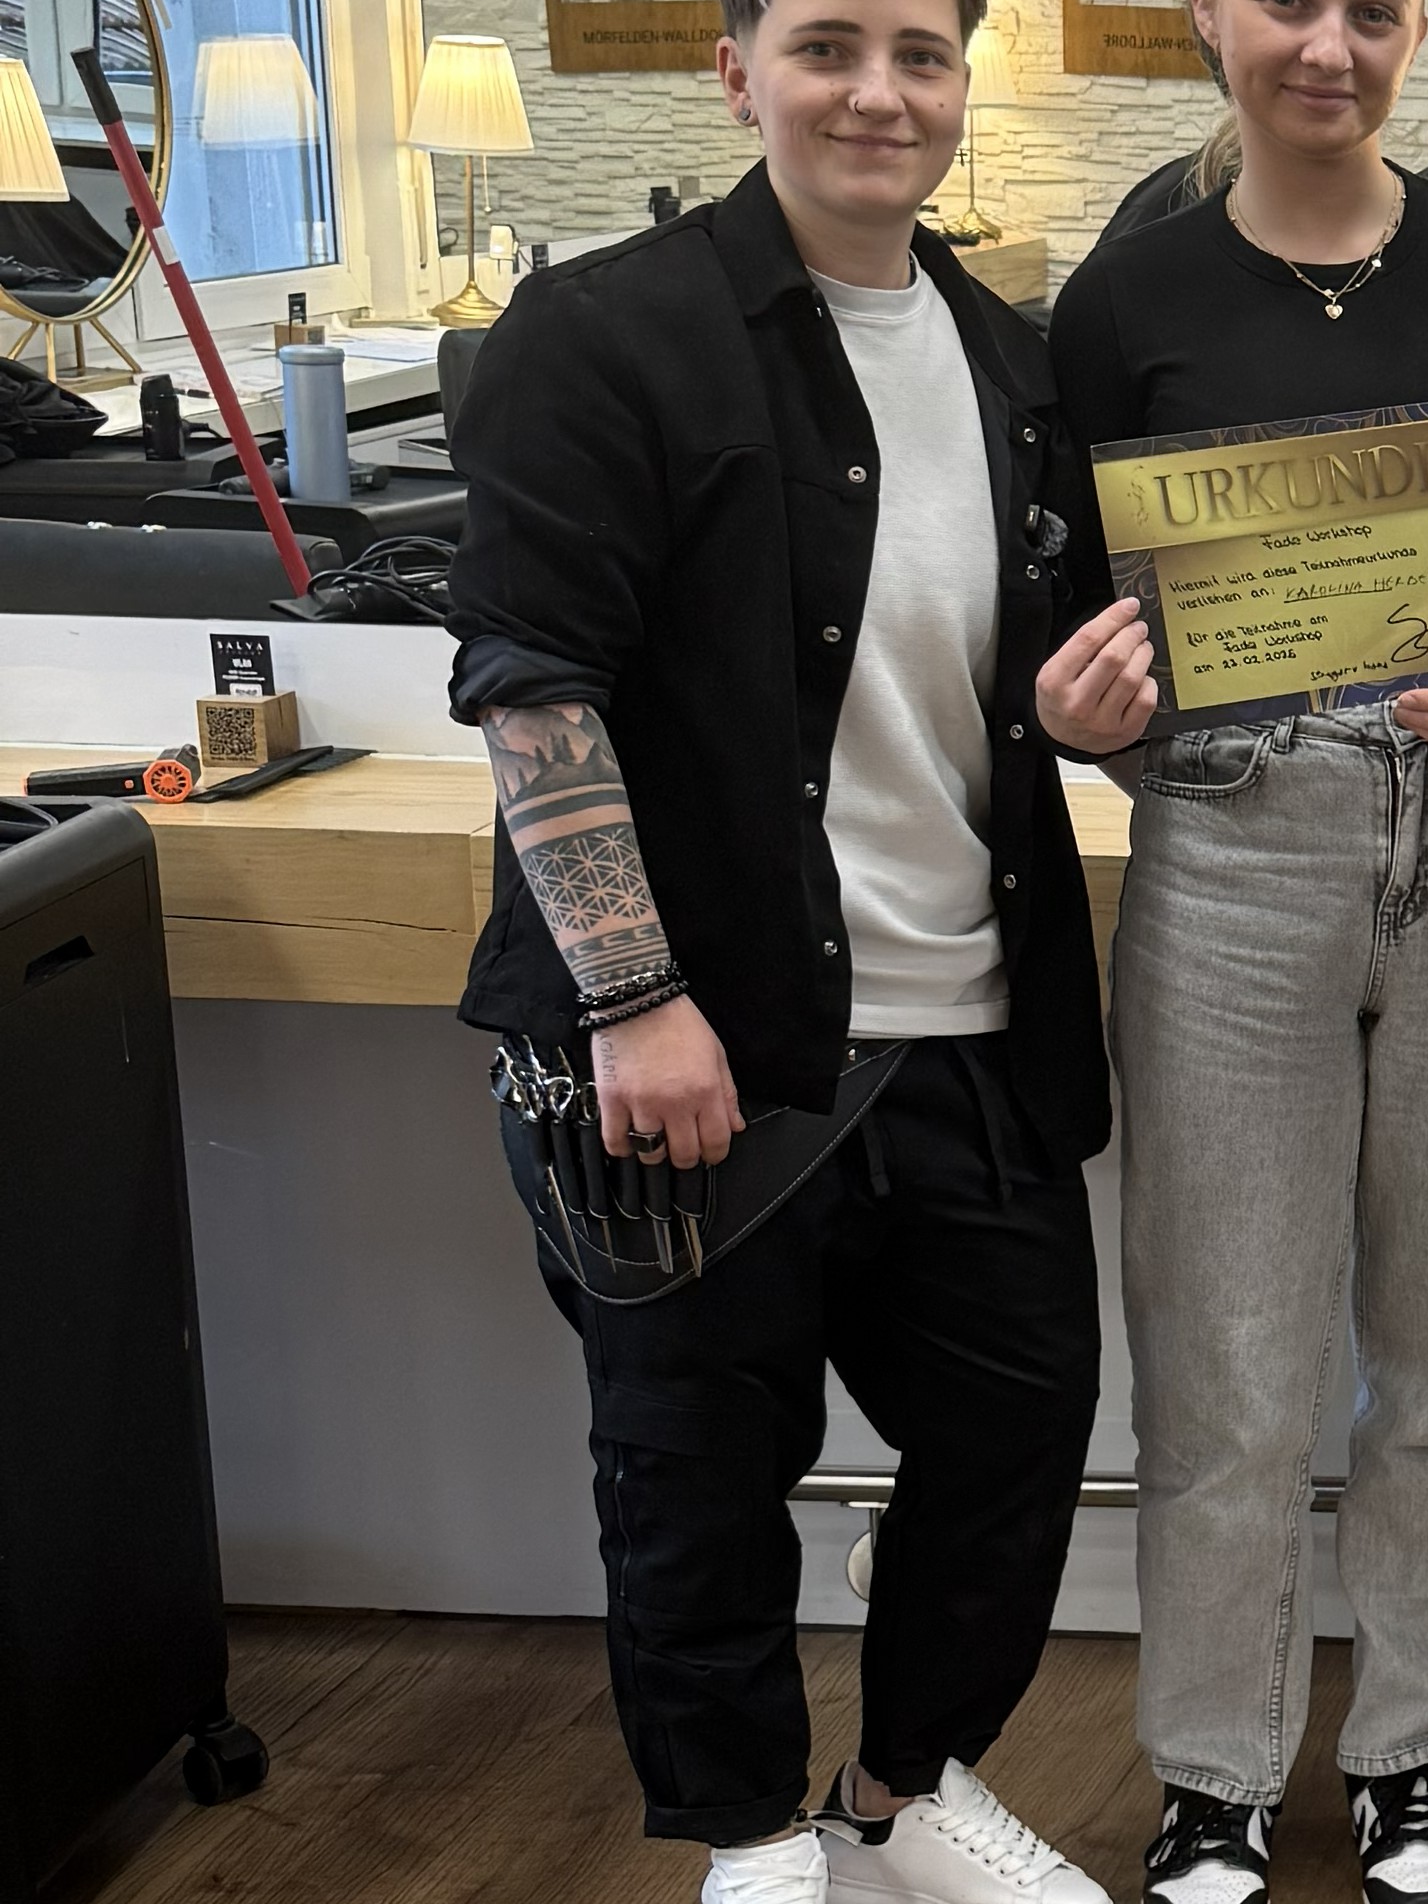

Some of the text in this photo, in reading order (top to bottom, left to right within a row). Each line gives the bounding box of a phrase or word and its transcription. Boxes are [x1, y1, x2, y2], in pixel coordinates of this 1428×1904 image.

[1260, 525, 1372, 550] Fade Workshop
[1310, 614, 1328, 624] am
[217, 641, 263, 650] SALVA
[1194, 664, 1215, 674] am
